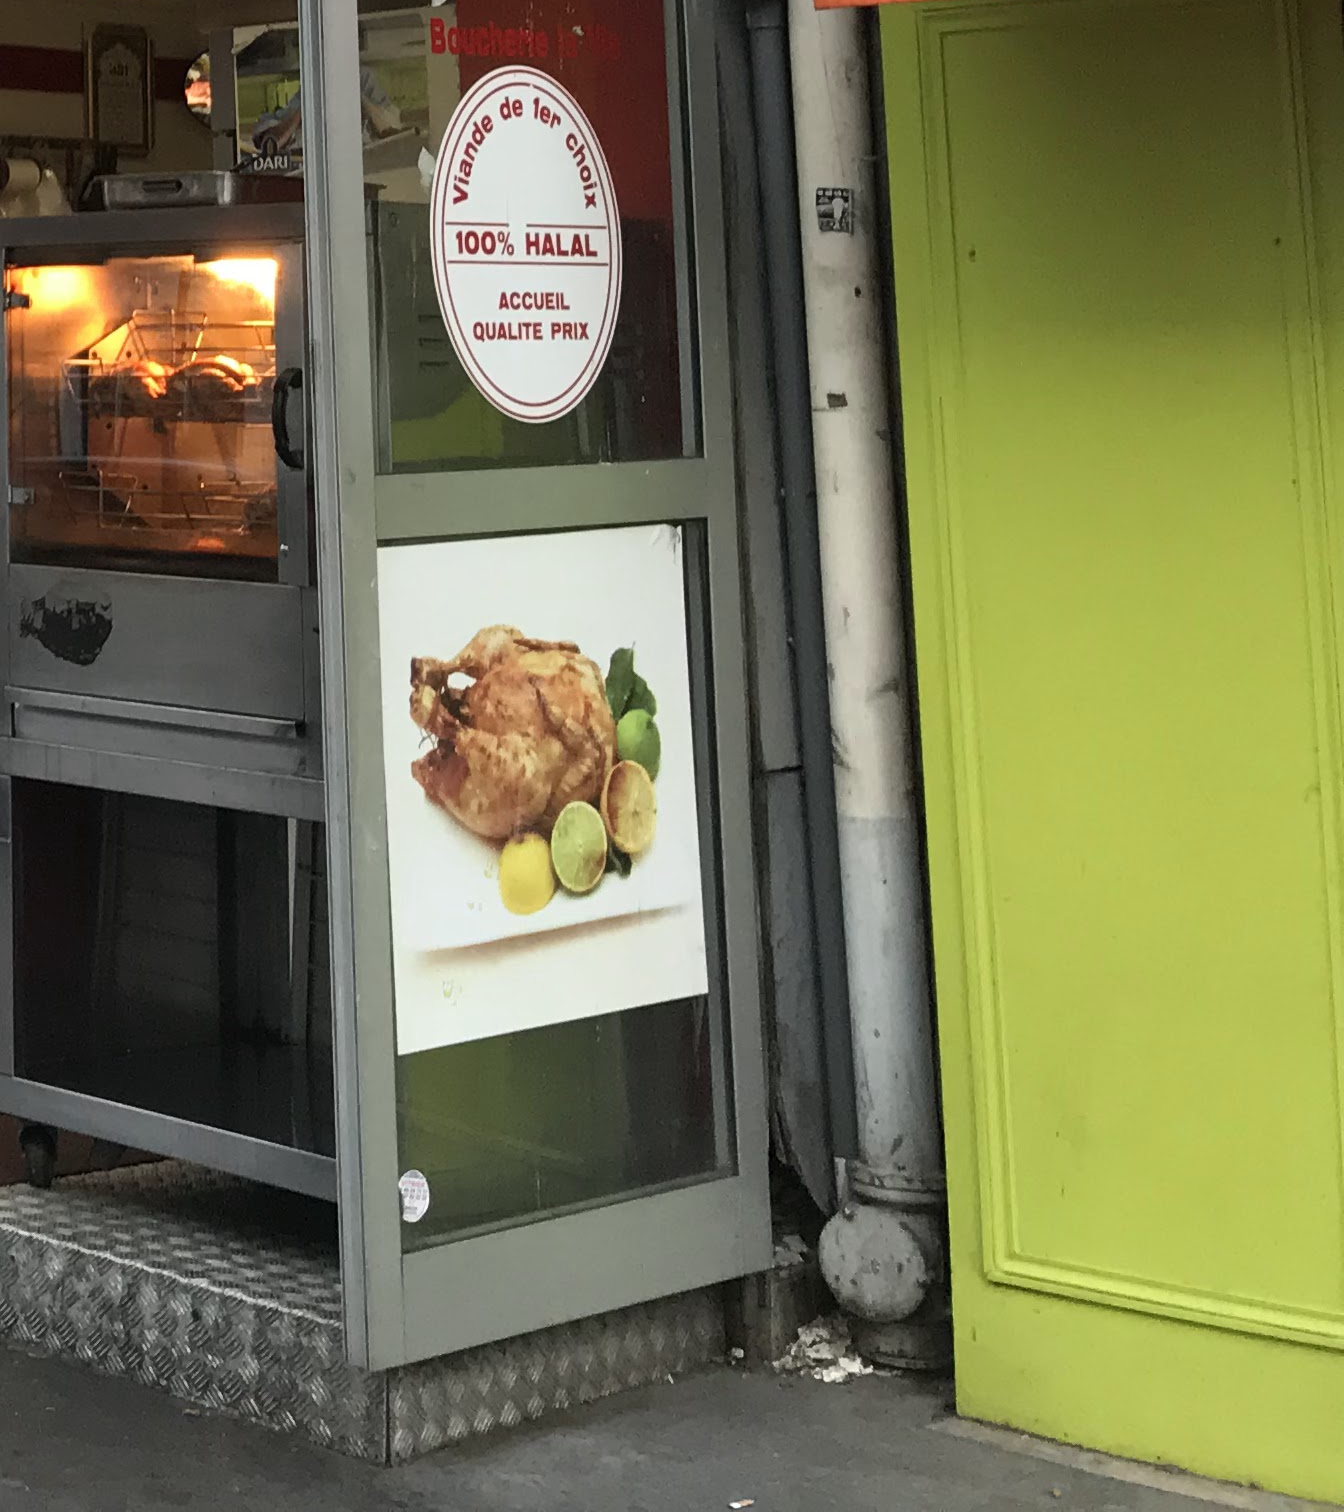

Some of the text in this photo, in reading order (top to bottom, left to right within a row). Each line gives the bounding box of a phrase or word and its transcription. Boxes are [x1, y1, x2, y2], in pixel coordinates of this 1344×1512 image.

[253, 155, 288, 171] DARI
[452, 96, 598, 210] Viande de 1er choix
[455, 230, 598, 257] 100% HALAL
[498, 291, 571, 311] ACCUEIL
[472, 321, 590, 343] QUALITE PRIX
